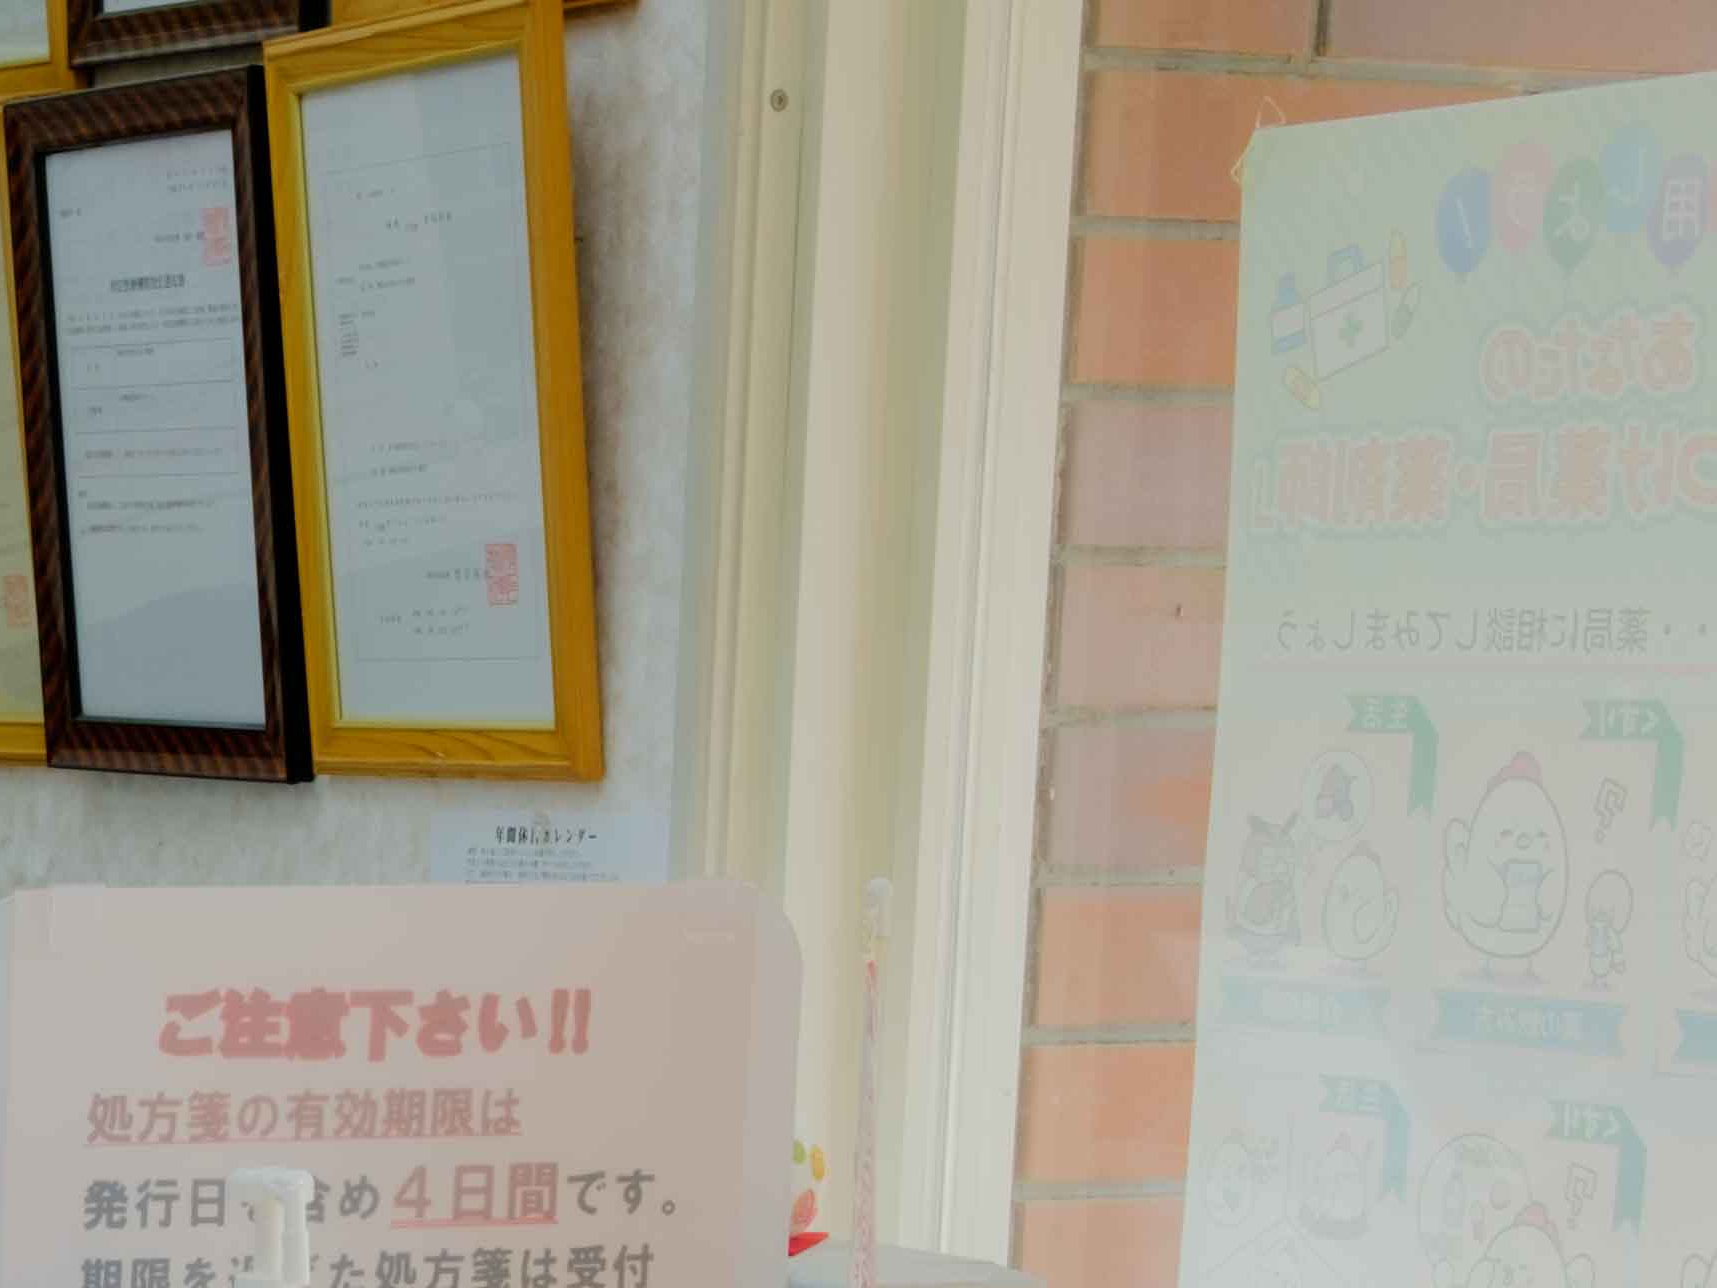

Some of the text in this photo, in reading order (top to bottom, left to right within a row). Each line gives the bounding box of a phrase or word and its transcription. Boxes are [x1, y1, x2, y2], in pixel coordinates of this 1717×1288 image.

[86, 1086, 522, 1141] 処方箋の有効期限は
[82, 1162, 676, 1229] 発行日め4日間です。
